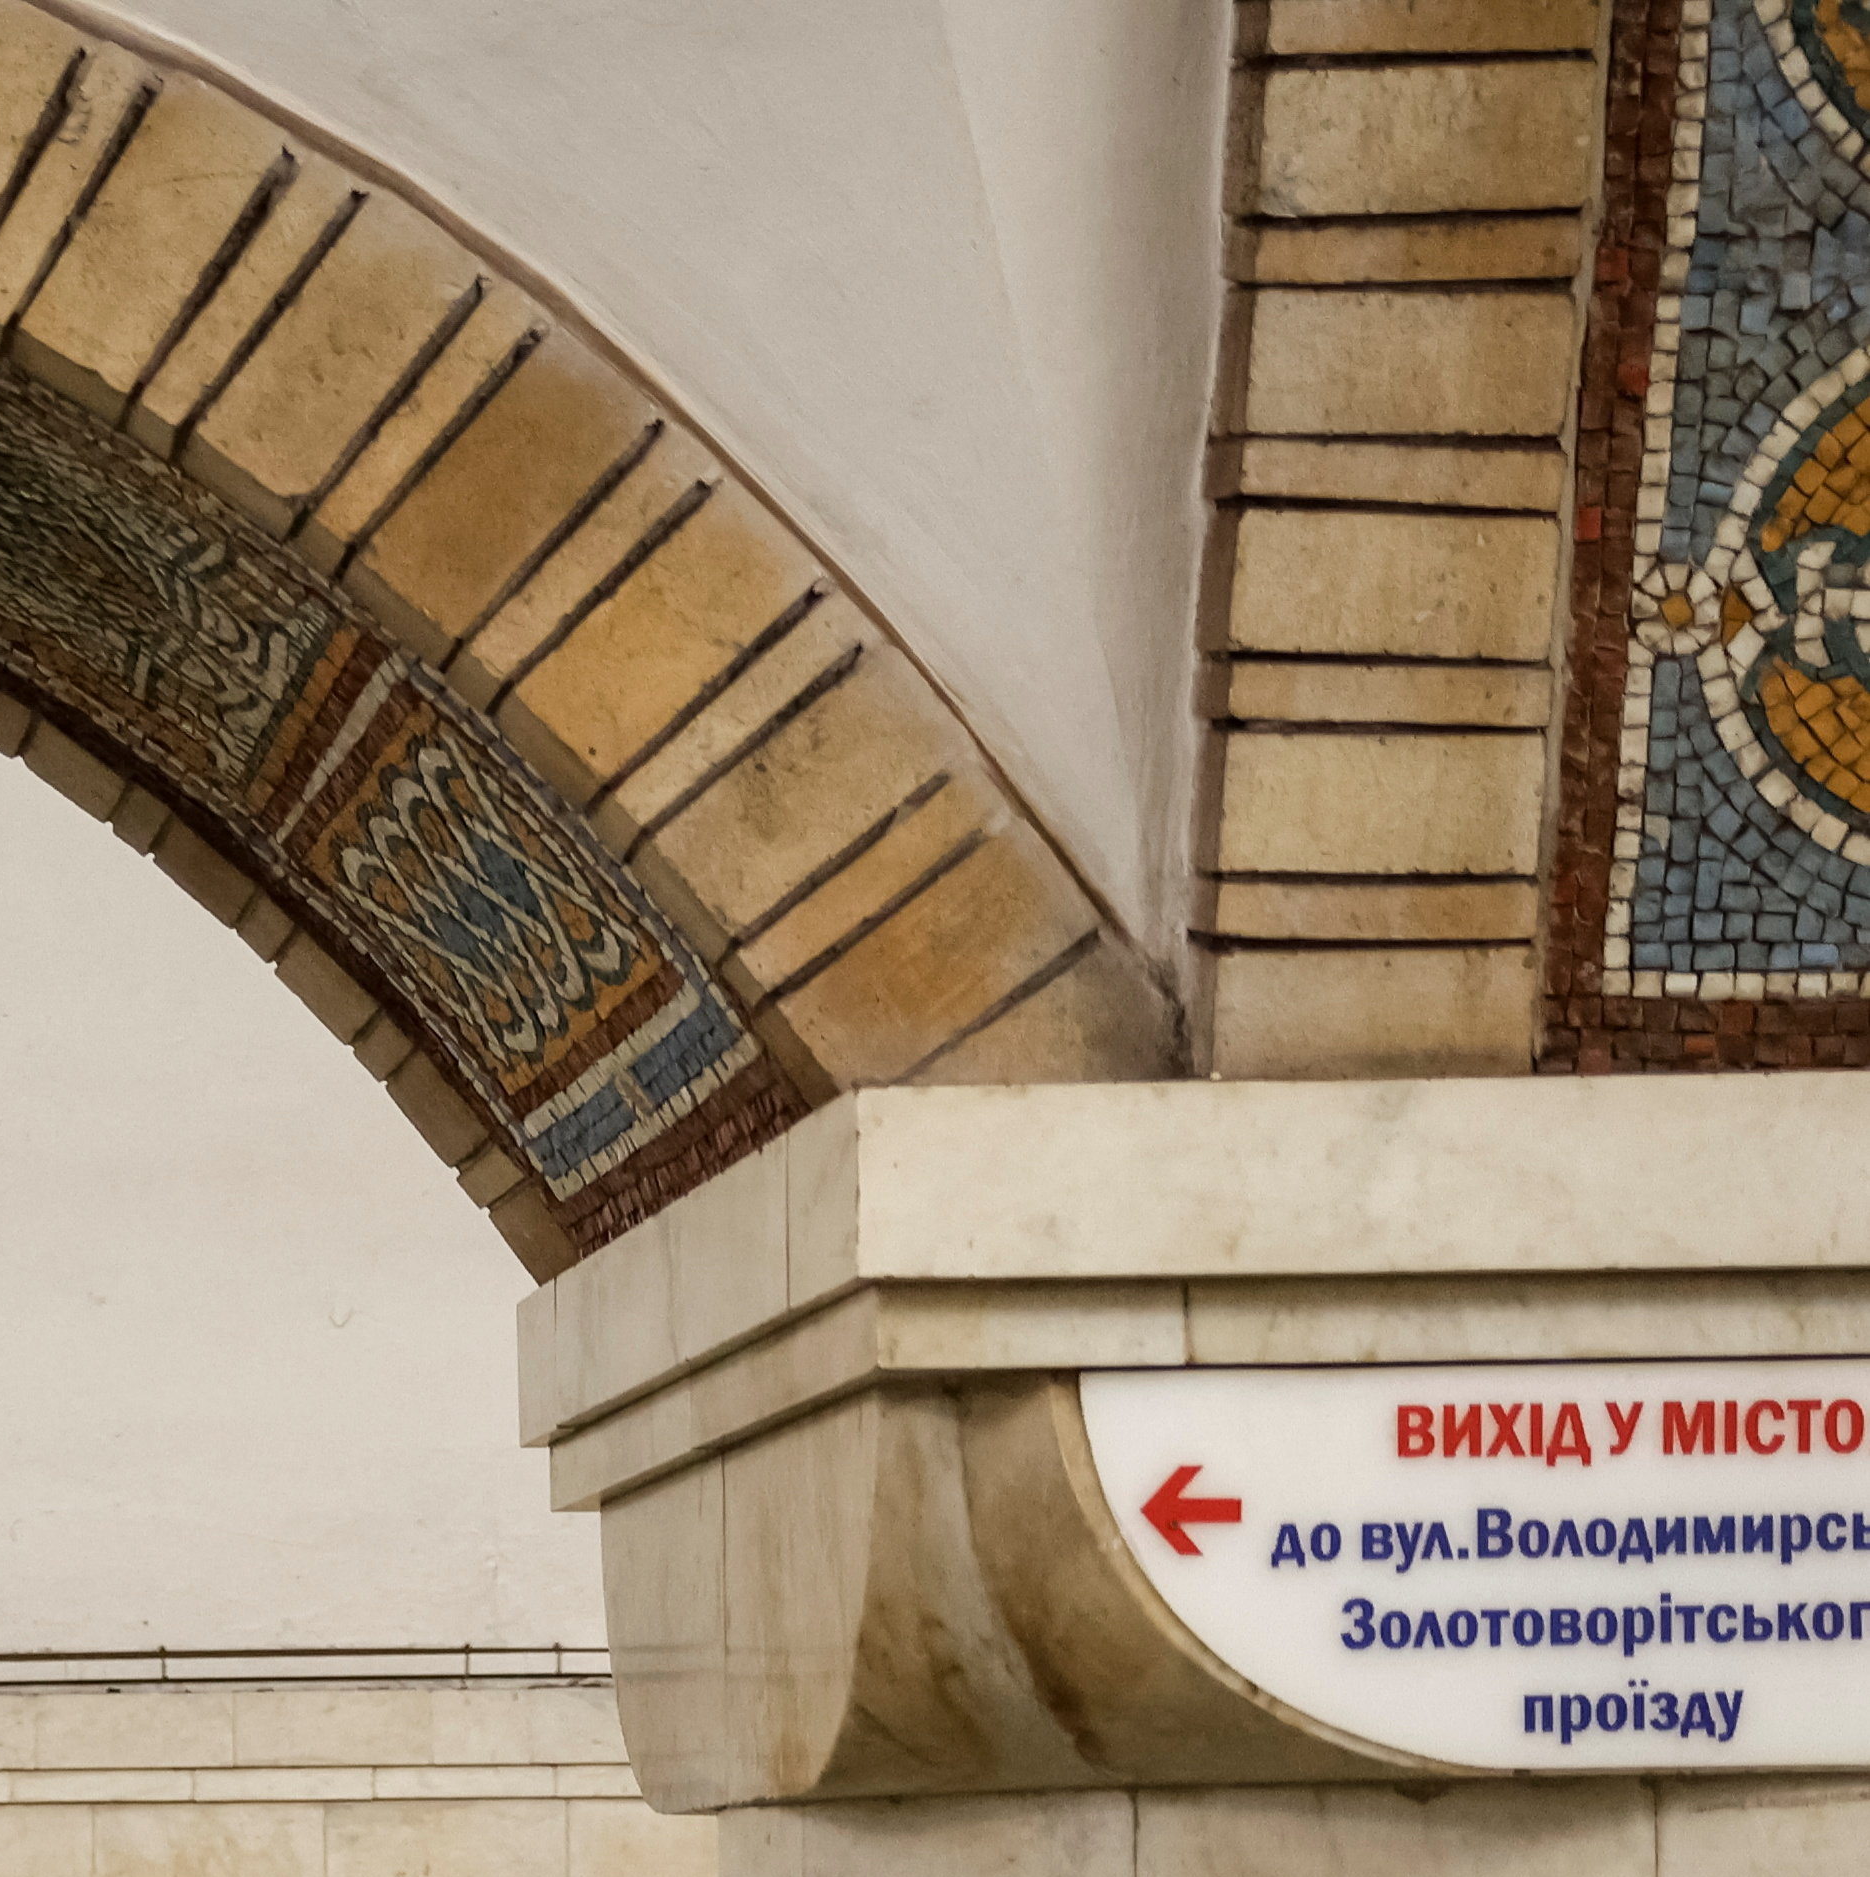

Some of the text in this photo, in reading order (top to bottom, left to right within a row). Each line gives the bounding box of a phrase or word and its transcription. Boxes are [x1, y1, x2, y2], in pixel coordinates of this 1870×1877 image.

[1396, 1397, 1866, 1468] ВИХІД У МІСТО
[1269, 1521, 1343, 1570] до
[1339, 1592, 1870, 1659] Золотоворітськог
[1522, 1678, 1745, 1747] проїзду
